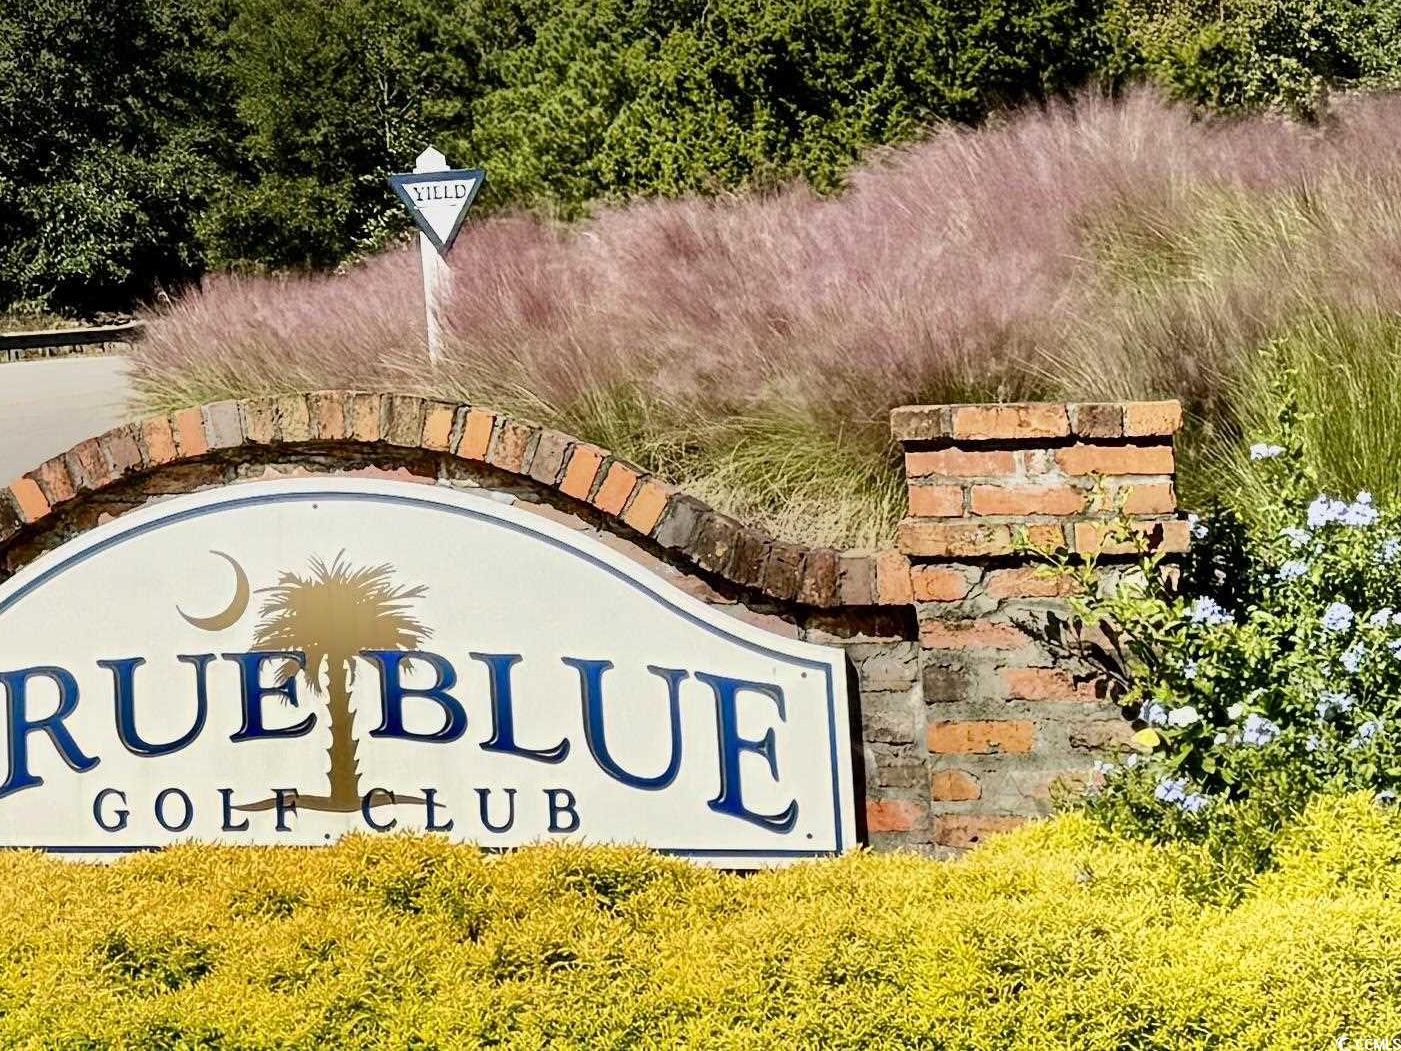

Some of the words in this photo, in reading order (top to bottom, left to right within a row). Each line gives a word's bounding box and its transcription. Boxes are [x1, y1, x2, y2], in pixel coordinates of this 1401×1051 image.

[412, 184, 467, 201] YIELD
[359, 650, 799, 834] BLUE
[93, 787, 299, 832] GOLF
[361, 787, 581, 833] CLUB
